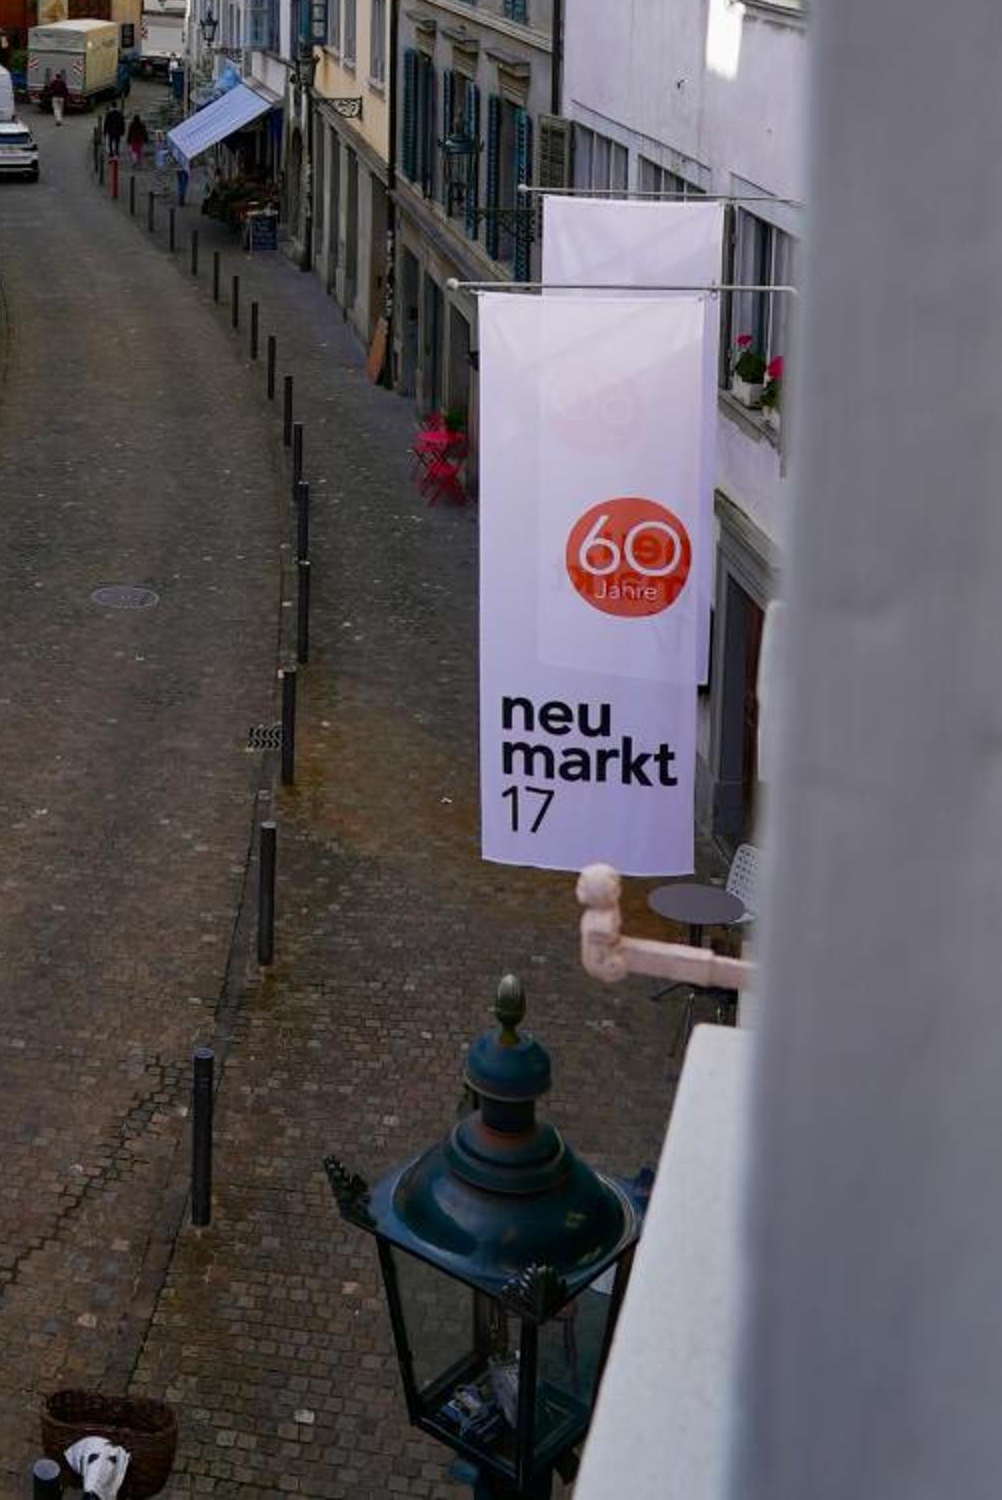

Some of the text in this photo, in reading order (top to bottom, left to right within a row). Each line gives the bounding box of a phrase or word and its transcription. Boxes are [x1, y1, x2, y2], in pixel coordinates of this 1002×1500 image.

[578, 515, 682, 577] 60
[594, 579, 658, 601] Jahre
[502, 696, 611, 738] neu
[502, 736, 678, 787] markt
[501, 785, 555, 834] 17
